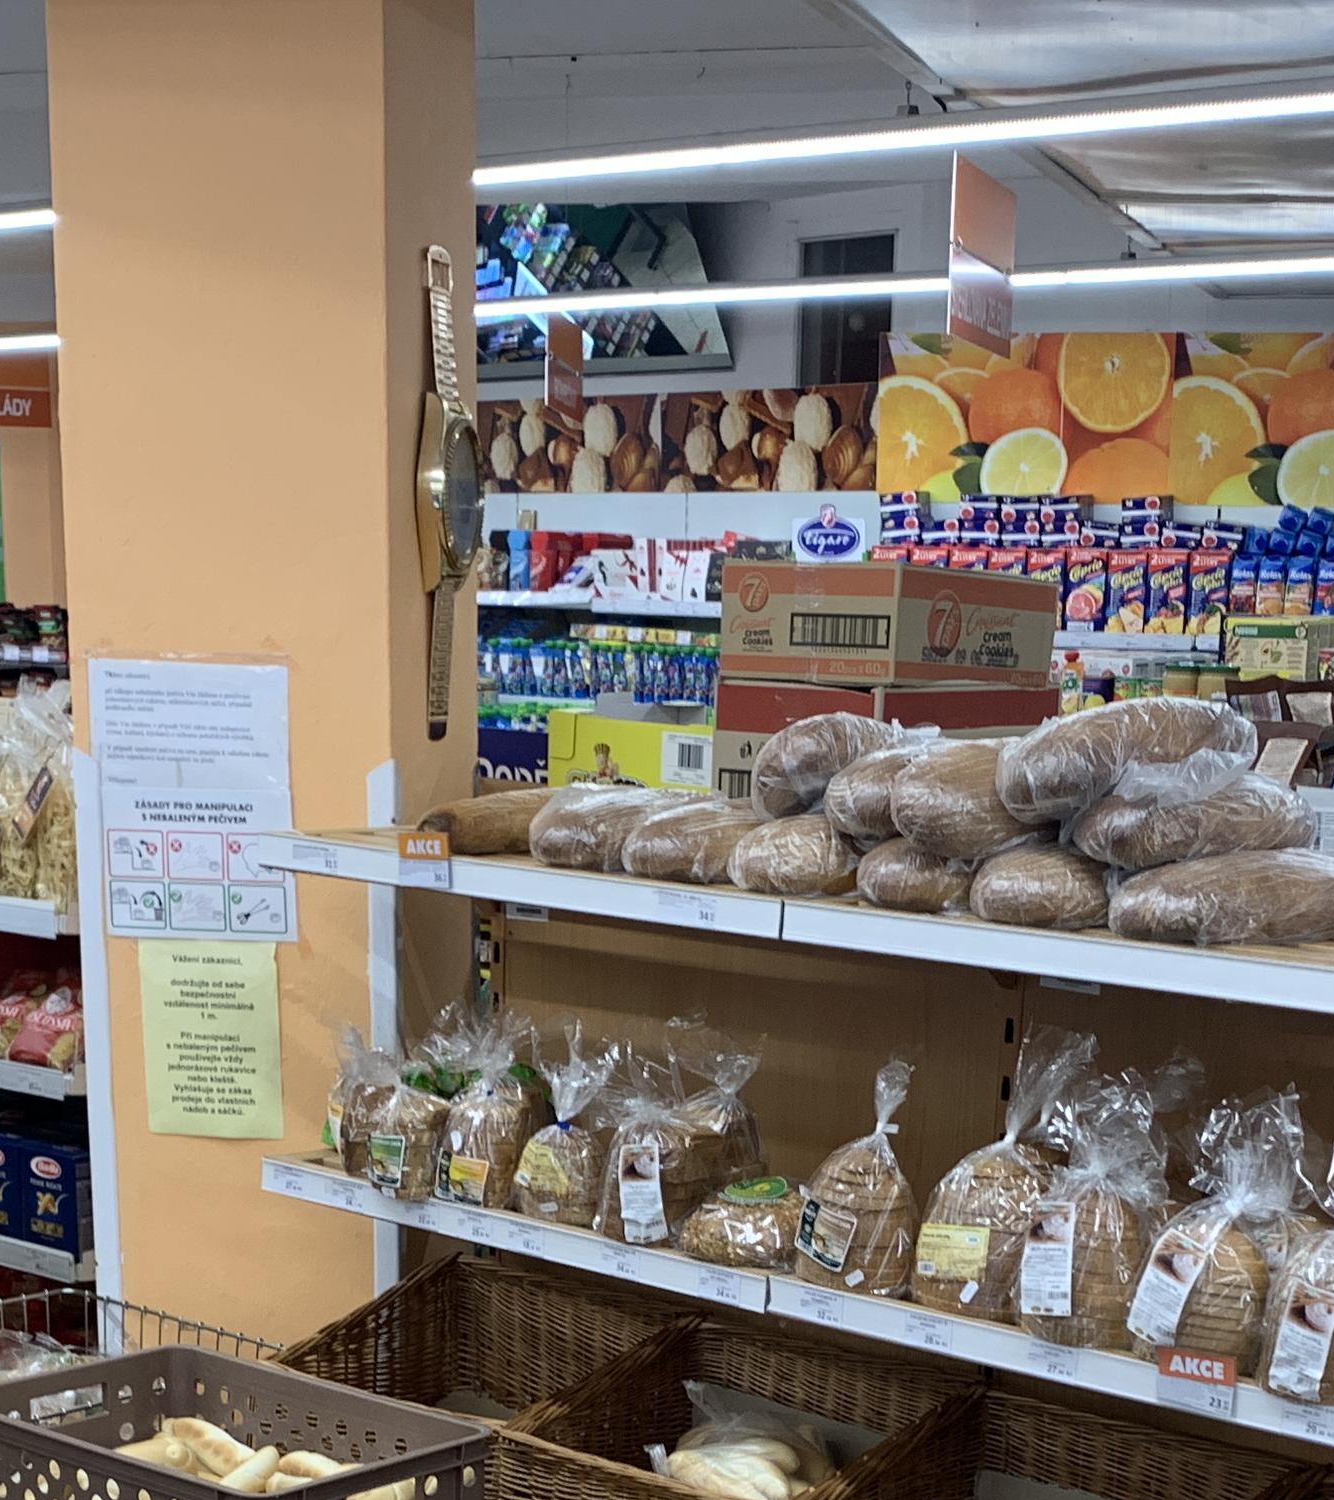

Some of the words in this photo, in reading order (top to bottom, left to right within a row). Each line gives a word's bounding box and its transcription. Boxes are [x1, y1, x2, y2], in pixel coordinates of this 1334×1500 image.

[134, 800, 170, 810] ZÁSADY
[173, 802, 192, 811] PRO
[195, 802, 253, 812] MANIPULACI
[149, 813, 205, 823] NEBALENÝM
[208, 814, 247, 824] PEČIVEM
[406, 839, 442, 856] AKCE
[1169, 1354, 1225, 1380] AKCE
